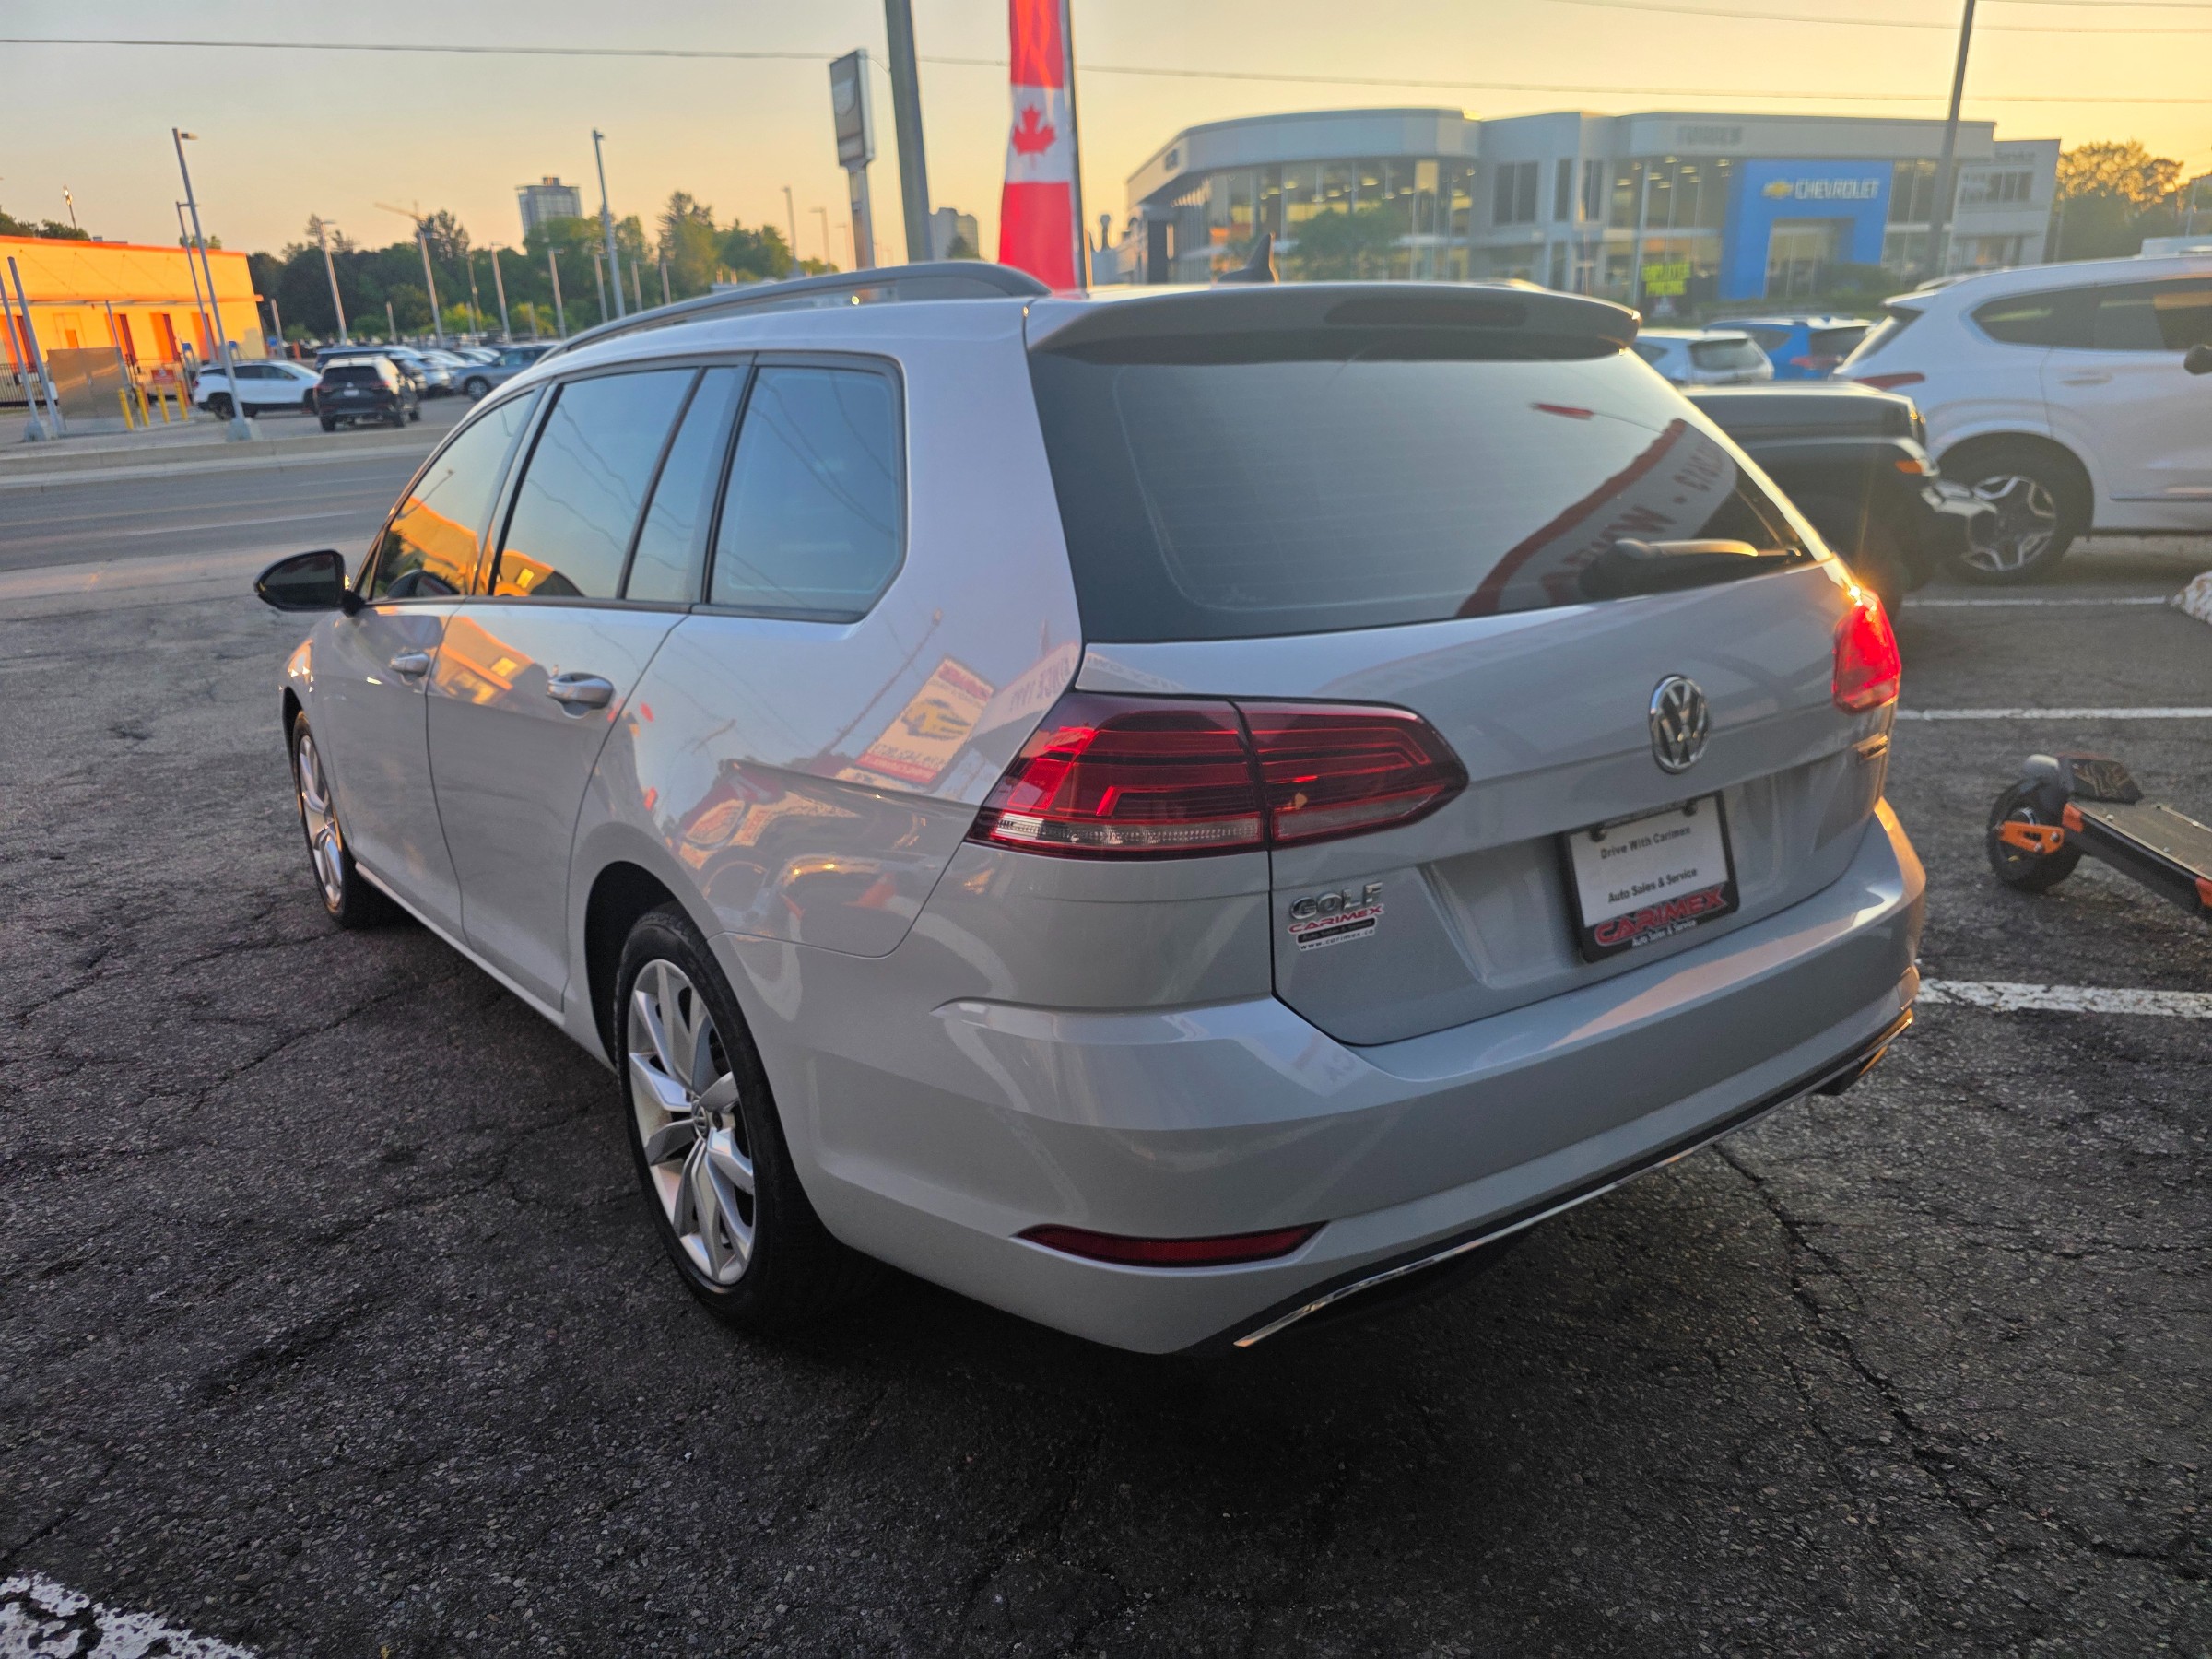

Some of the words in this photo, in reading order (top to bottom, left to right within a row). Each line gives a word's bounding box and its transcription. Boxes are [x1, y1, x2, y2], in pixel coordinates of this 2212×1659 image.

[1794, 177, 1879, 200] CHEVROLET
[1600, 845, 1627, 859] Drive
[1629, 836, 1652, 850] With
[1653, 827, 1690, 843] Carimex
[1290, 882, 1383, 920] GOLF
[1607, 891, 1630, 903] Auto
[1630, 881, 1656, 897] Sales
[1657, 877, 1665, 888] &
[1665, 868, 1698, 885] Service
[1289, 905, 1383, 933] CARIMEX
[1594, 887, 1727, 946] CARIMEX
